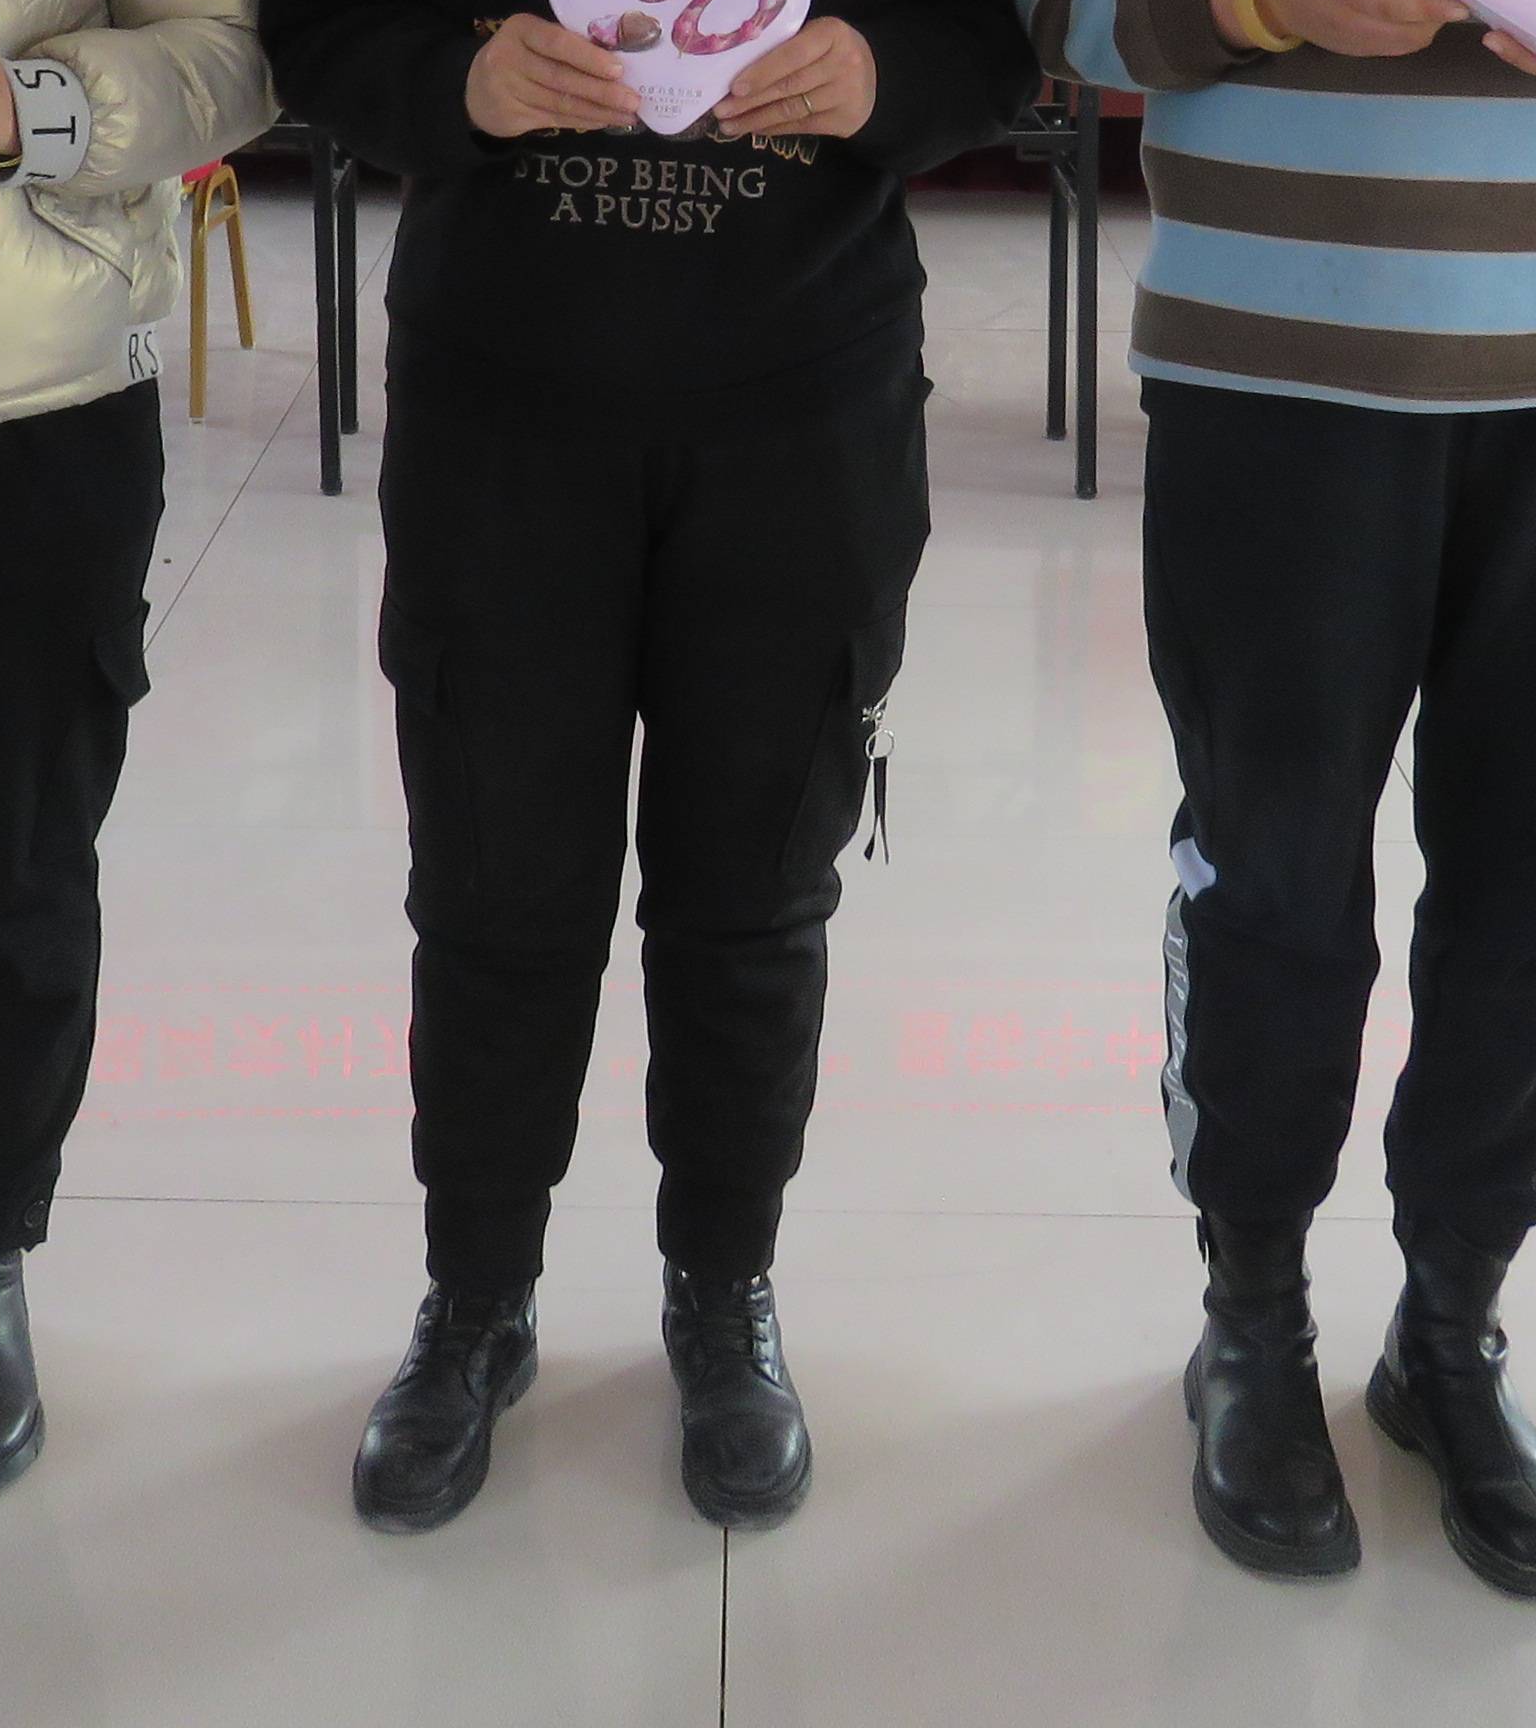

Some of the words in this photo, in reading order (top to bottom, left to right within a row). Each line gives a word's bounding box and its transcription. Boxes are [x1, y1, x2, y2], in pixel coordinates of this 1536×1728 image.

[631, 158, 766, 200] BEING
[550, 193, 582, 223] A
[595, 194, 723, 234] PUSSY
